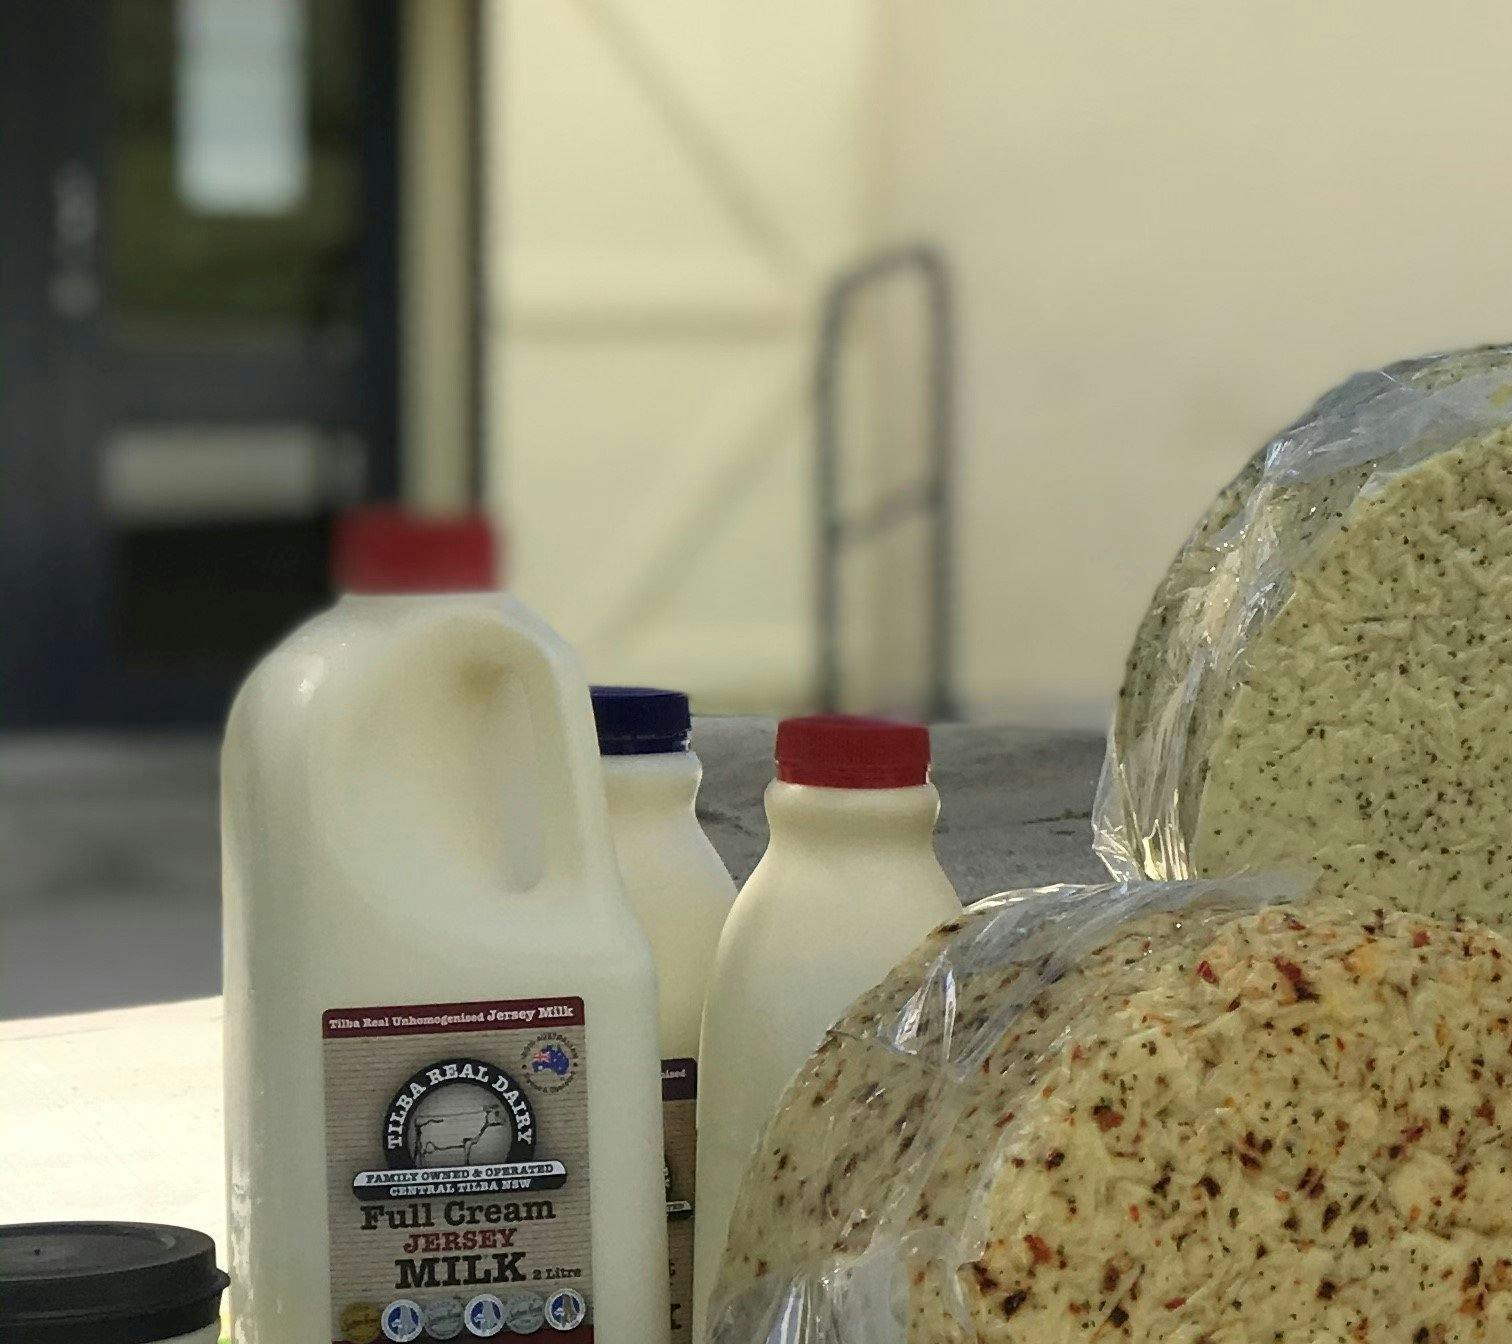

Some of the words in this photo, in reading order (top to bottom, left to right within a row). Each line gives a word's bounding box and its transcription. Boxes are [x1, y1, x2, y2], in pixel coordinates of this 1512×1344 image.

[329, 1018, 360, 1030] Tilba
[363, 1017, 389, 1028] Real
[392, 1010, 485, 1027] Unhomogenised
[487, 1007, 535, 1022] Jersey
[538, 1005, 574, 1019] Milk
[387, 1082, 427, 1150] TILBA
[426, 1064, 490, 1086] REAL
[492, 1074, 532, 1145] DAIRY
[366, 1171, 419, 1184] FAMILY
[421, 1169, 470, 1181] OWNED
[472, 1169, 483, 1179] &
[485, 1164, 554, 1178] OPERATED
[389, 1183, 455, 1197] CENTRAL
[458, 1181, 499, 1193] TILBA
[501, 1178, 532, 1190] NSW
[360, 1203, 434, 1230] Full
[443, 1199, 556, 1227] Cream
[403, 1228, 517, 1254] JERSEY
[395, 1252, 526, 1289] MILK
[532, 1269, 541, 1280] 2
[545, 1267, 582, 1280] Litre
